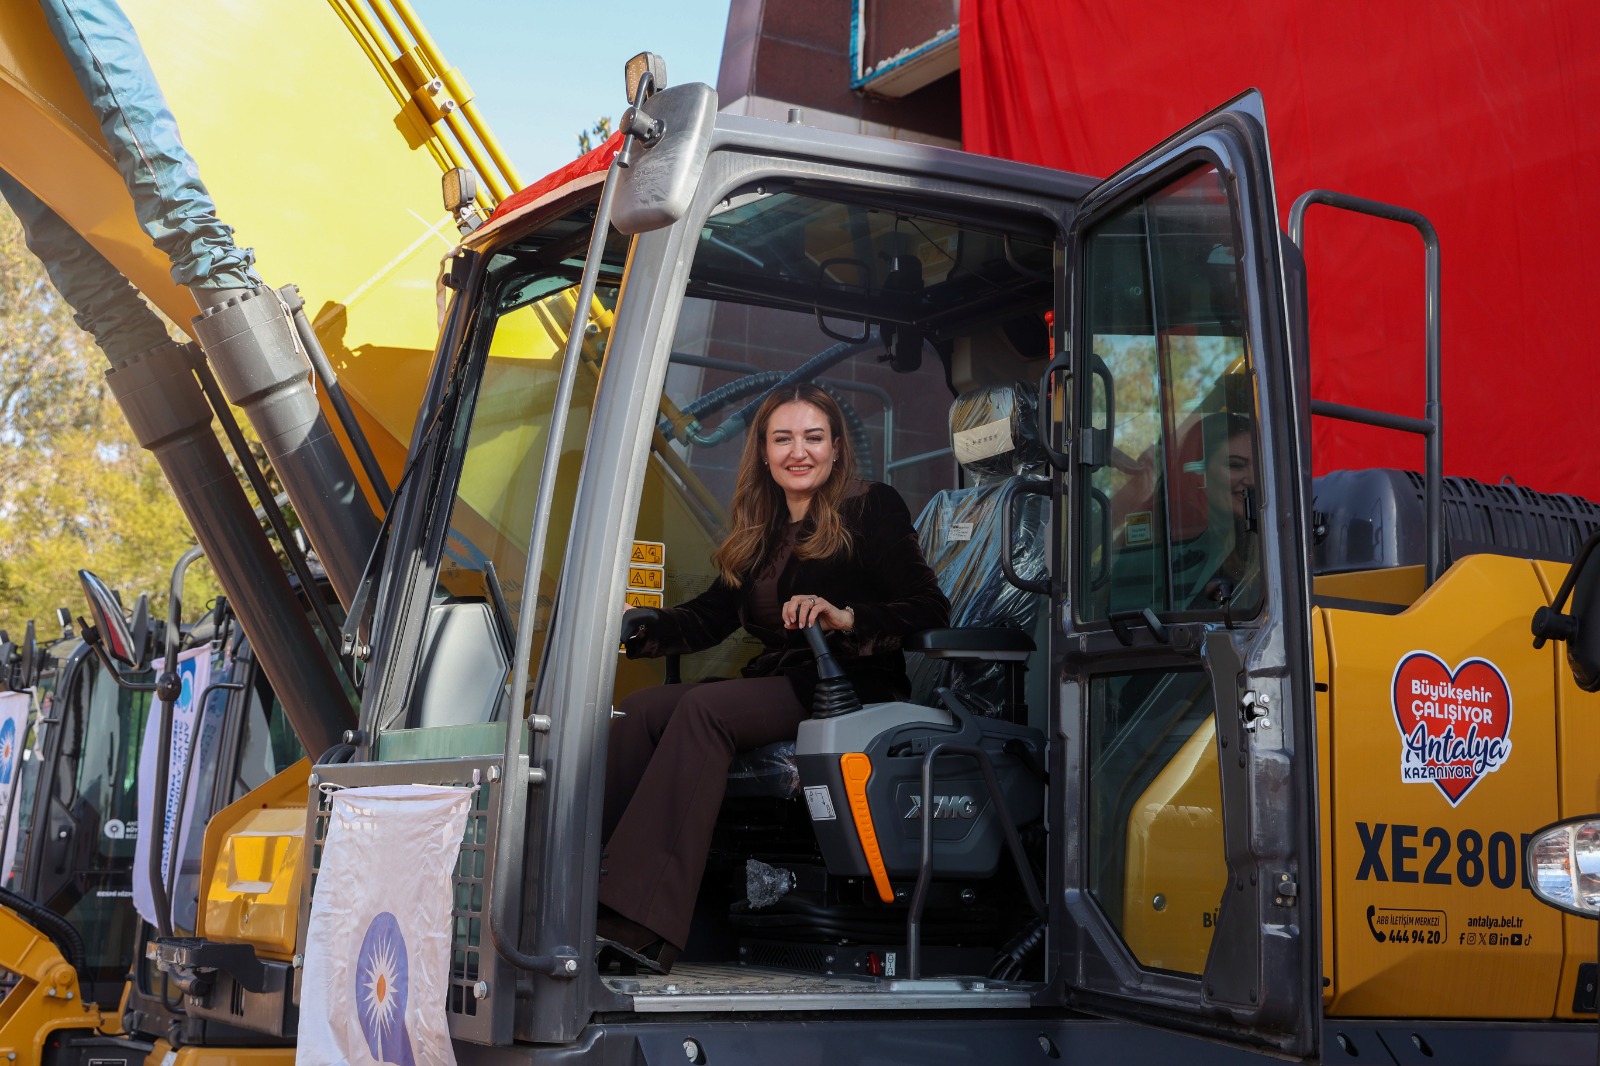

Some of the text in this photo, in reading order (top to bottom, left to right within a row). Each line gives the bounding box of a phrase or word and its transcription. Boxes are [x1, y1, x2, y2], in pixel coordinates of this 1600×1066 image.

[1411, 679, 1493, 704] Büyükşehir
[1411, 699, 1493, 725] ÇALIŞIYOR
[1405, 723, 1508, 775] Antalya
[1404, 766, 1472, 779] KAZANIYOR
[1390, 914, 1414, 928] İLETİŞİM
[1415, 915, 1440, 927] MERKEZİ
[1467, 915, 1524, 929] antalya.bel.tr
[1389, 929, 1441, 945] 444 94 20
